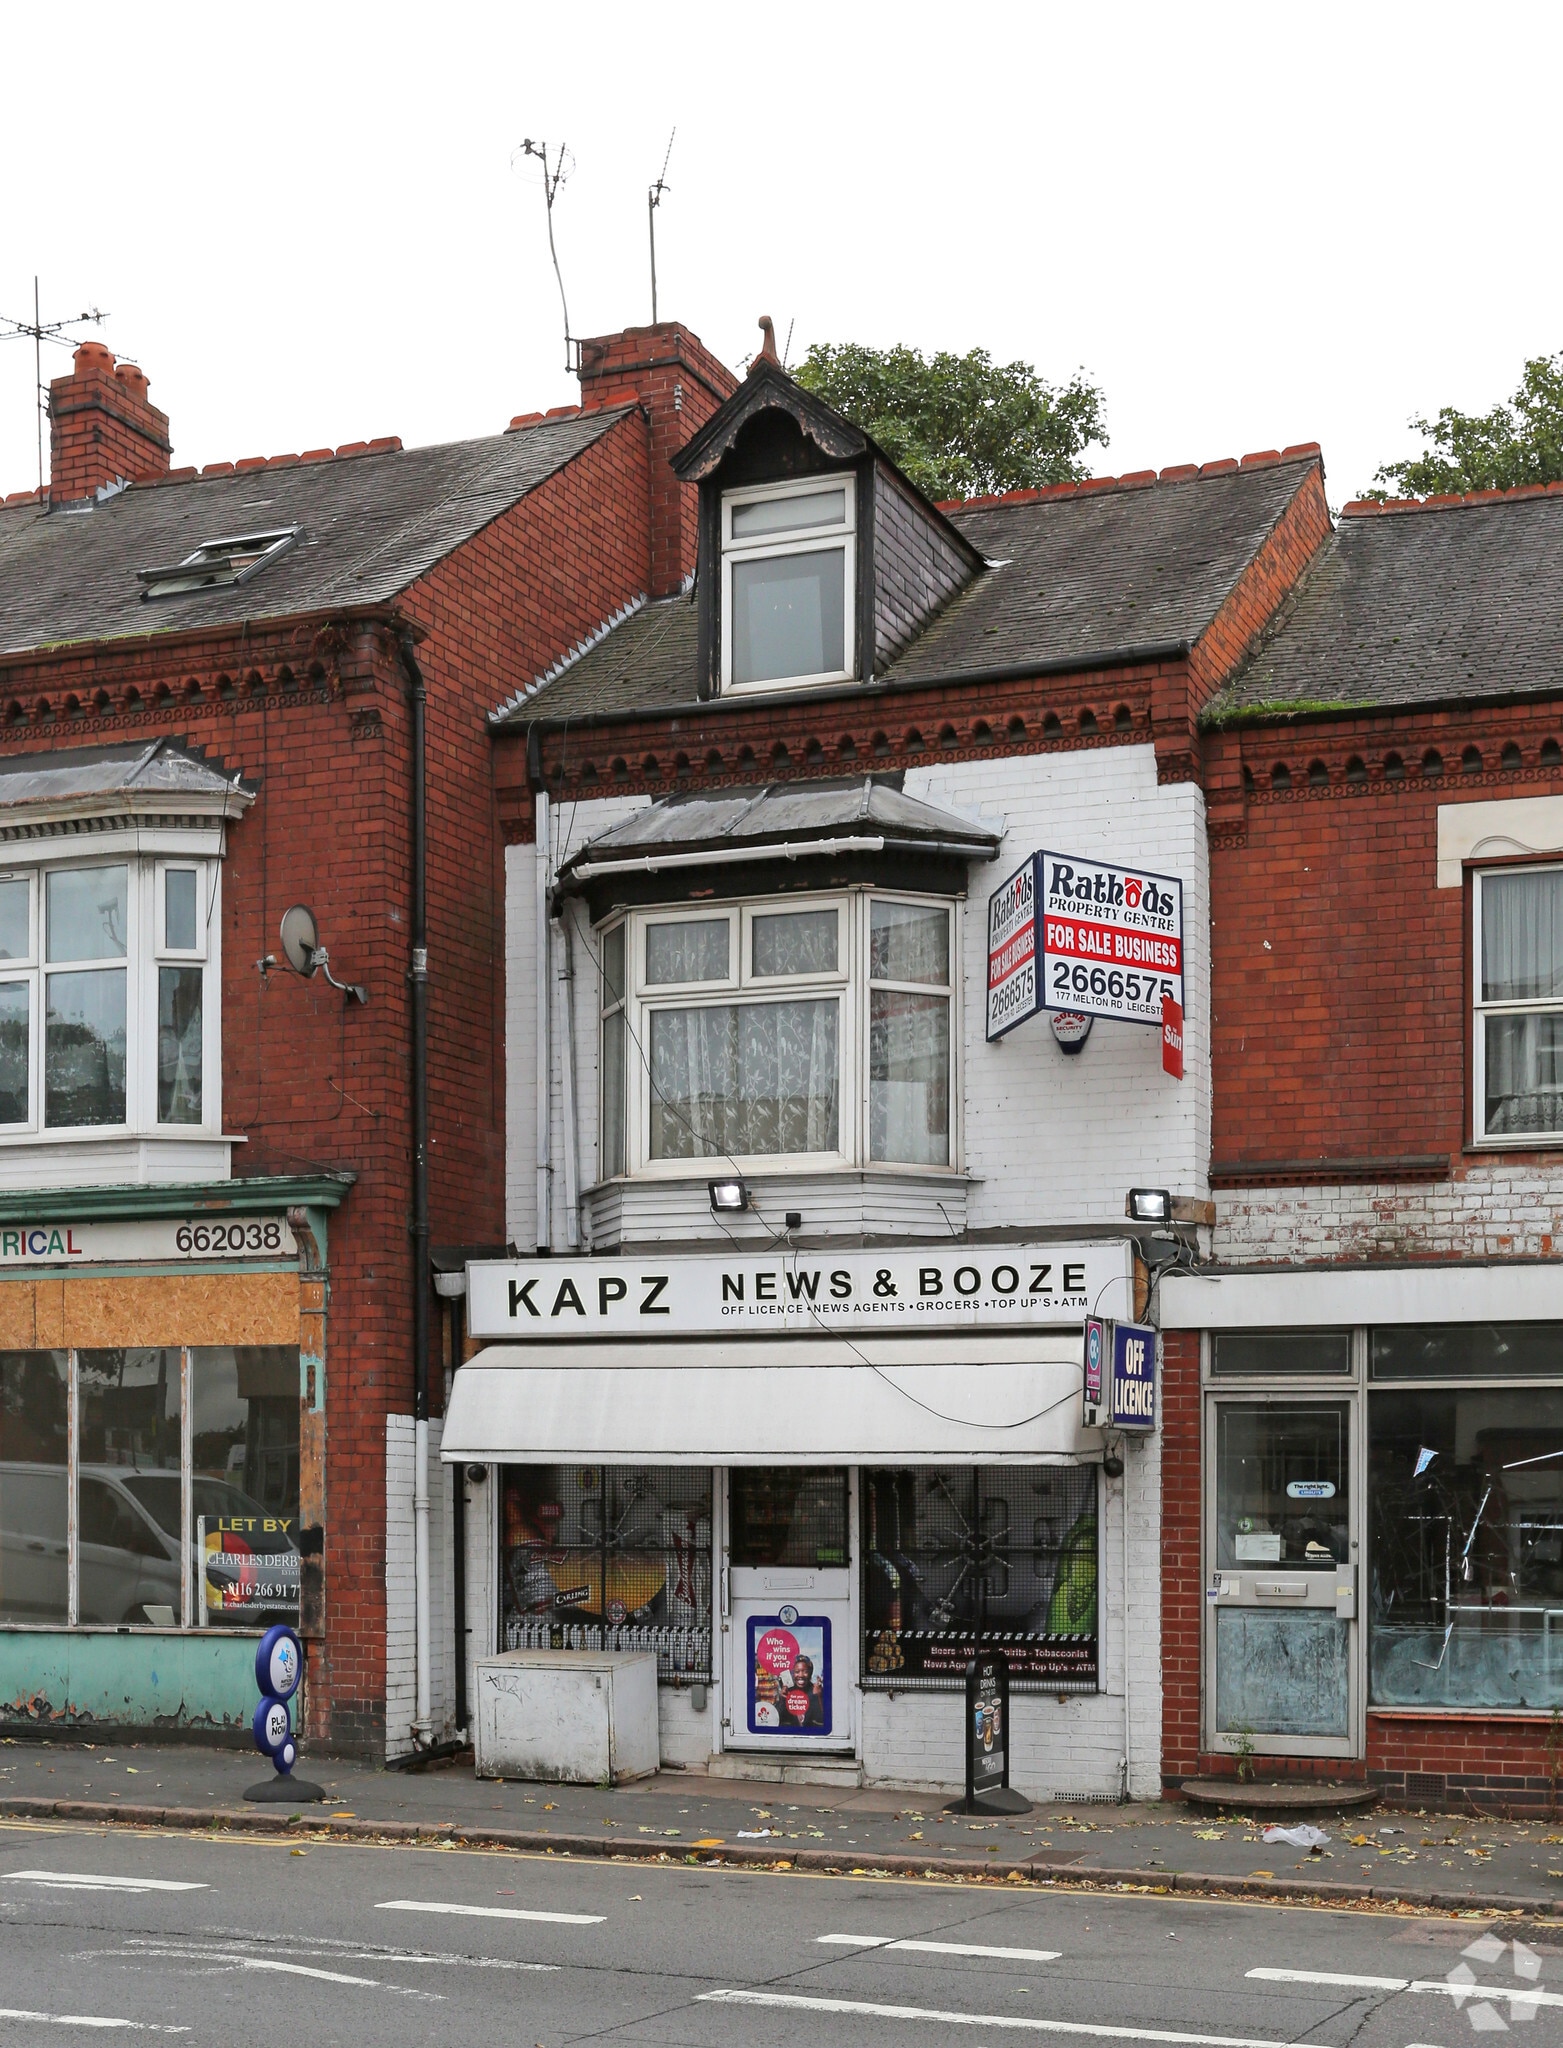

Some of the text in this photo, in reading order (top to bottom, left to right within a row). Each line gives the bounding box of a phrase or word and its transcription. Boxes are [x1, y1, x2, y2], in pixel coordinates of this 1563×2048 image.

[993, 872, 1033, 932] Rathods
[1049, 862, 1174, 916] Rathods
[1049, 896, 1174, 931] PROPERTY CENTRE
[1047, 923, 1177, 967] FOR SALE BUSINESS
[990, 956, 1001, 982] FOR
[992, 965, 1034, 1019] 2666575
[1053, 961, 1174, 1005] 2666575
[1056, 991, 1164, 1016] 177 MELTON RD LEICESTE
[1164, 1024, 1182, 1051] Sun
[0, 1229, 82, 1256] RICAL
[176, 1222, 281, 1252] 662038
[508, 1263, 1087, 1317] KAPZ NEWS & BOOZE
[721, 1297, 1088, 1315] OFF LICENCE NEWS AGENTS GROCERS TOP UP'S ATM
[1126, 1338, 1144, 1375] OFF
[1114, 1378, 1153, 1416] LICENCE
[218, 1518, 292, 1532] LET BY
[207, 1552, 262, 1566] CHARLES
[228, 1582, 252, 1596] 0116
[254, 1583, 273, 1597] 266
[275, 1584, 287, 1597] 91
[556, 1589, 588, 1605] CARLING
[773, 1654, 787, 1662] you
[931, 1647, 955, 1655] Beers
[999, 1648, 1088, 1658] pirits Tobacconist
[924, 1660, 966, 1670] News Age
[983, 1665, 993, 1677] HOT
[1030, 1662, 1046, 1671] Top
[1048, 1663, 1068, 1671] Up's
[1076, 1663, 1096, 1671] ATM
